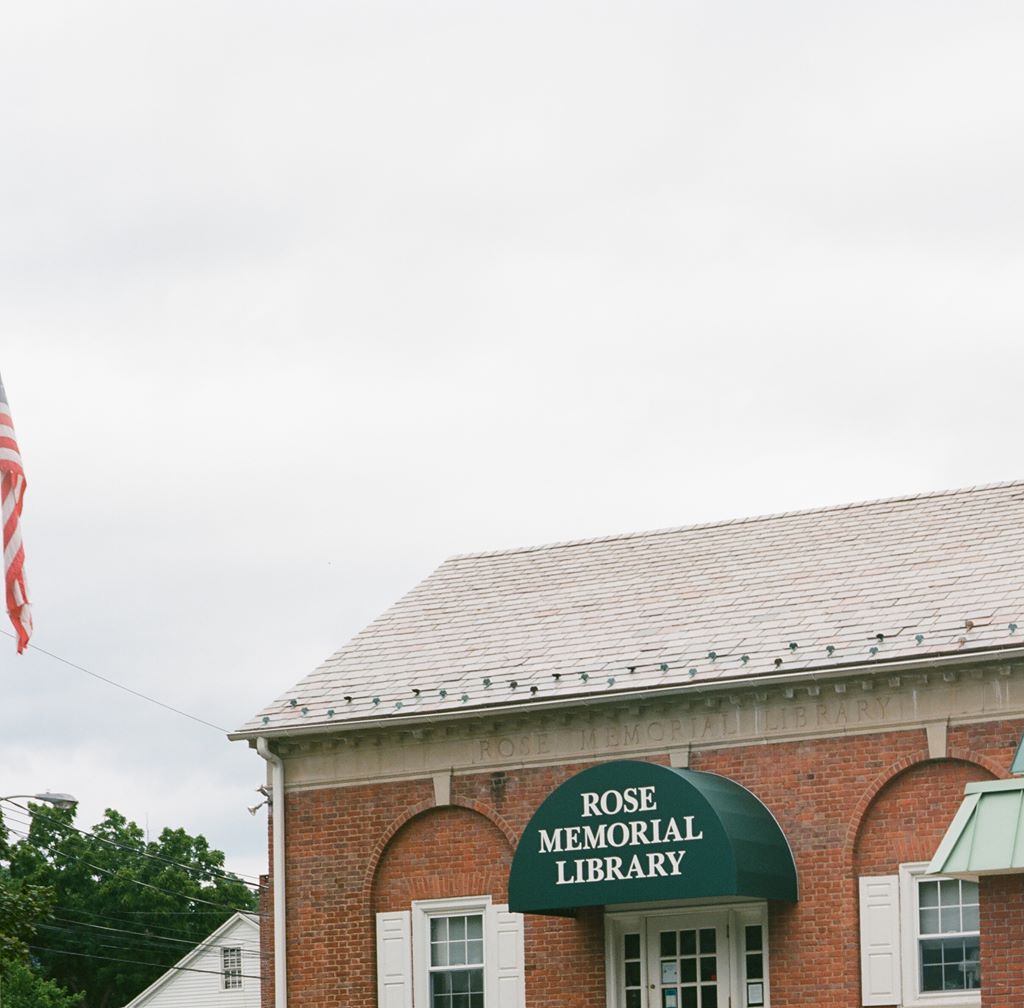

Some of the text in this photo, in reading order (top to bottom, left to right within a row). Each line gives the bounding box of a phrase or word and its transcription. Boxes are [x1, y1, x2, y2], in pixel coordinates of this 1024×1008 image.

[479, 697, 890, 760] ROSE MEMORIAL LIBRARY
[580, 786, 657, 818] ROSE
[538, 816, 703, 853] MEMORIAL
[555, 850, 686, 885] LIBRARY
